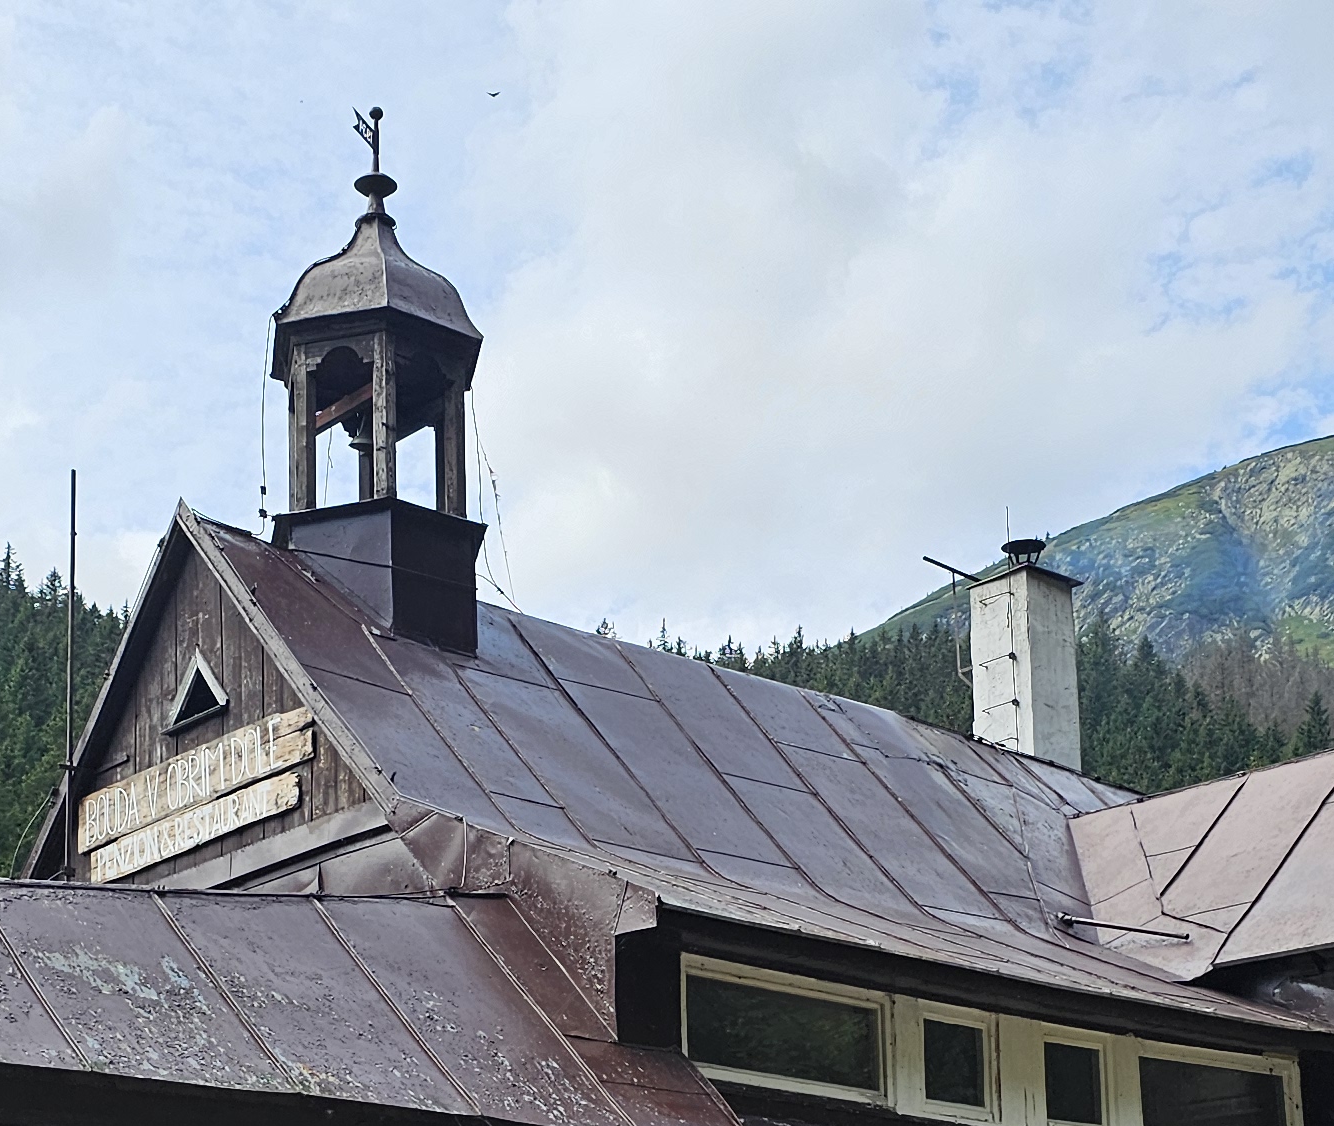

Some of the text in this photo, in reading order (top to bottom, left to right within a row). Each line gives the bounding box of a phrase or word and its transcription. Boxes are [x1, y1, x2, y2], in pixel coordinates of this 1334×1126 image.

[85, 717, 282, 847] BOUDA V OBŘÍM DOLE
[95, 828, 160, 883] PENZION
[175, 784, 270, 846] RESTAURANT
